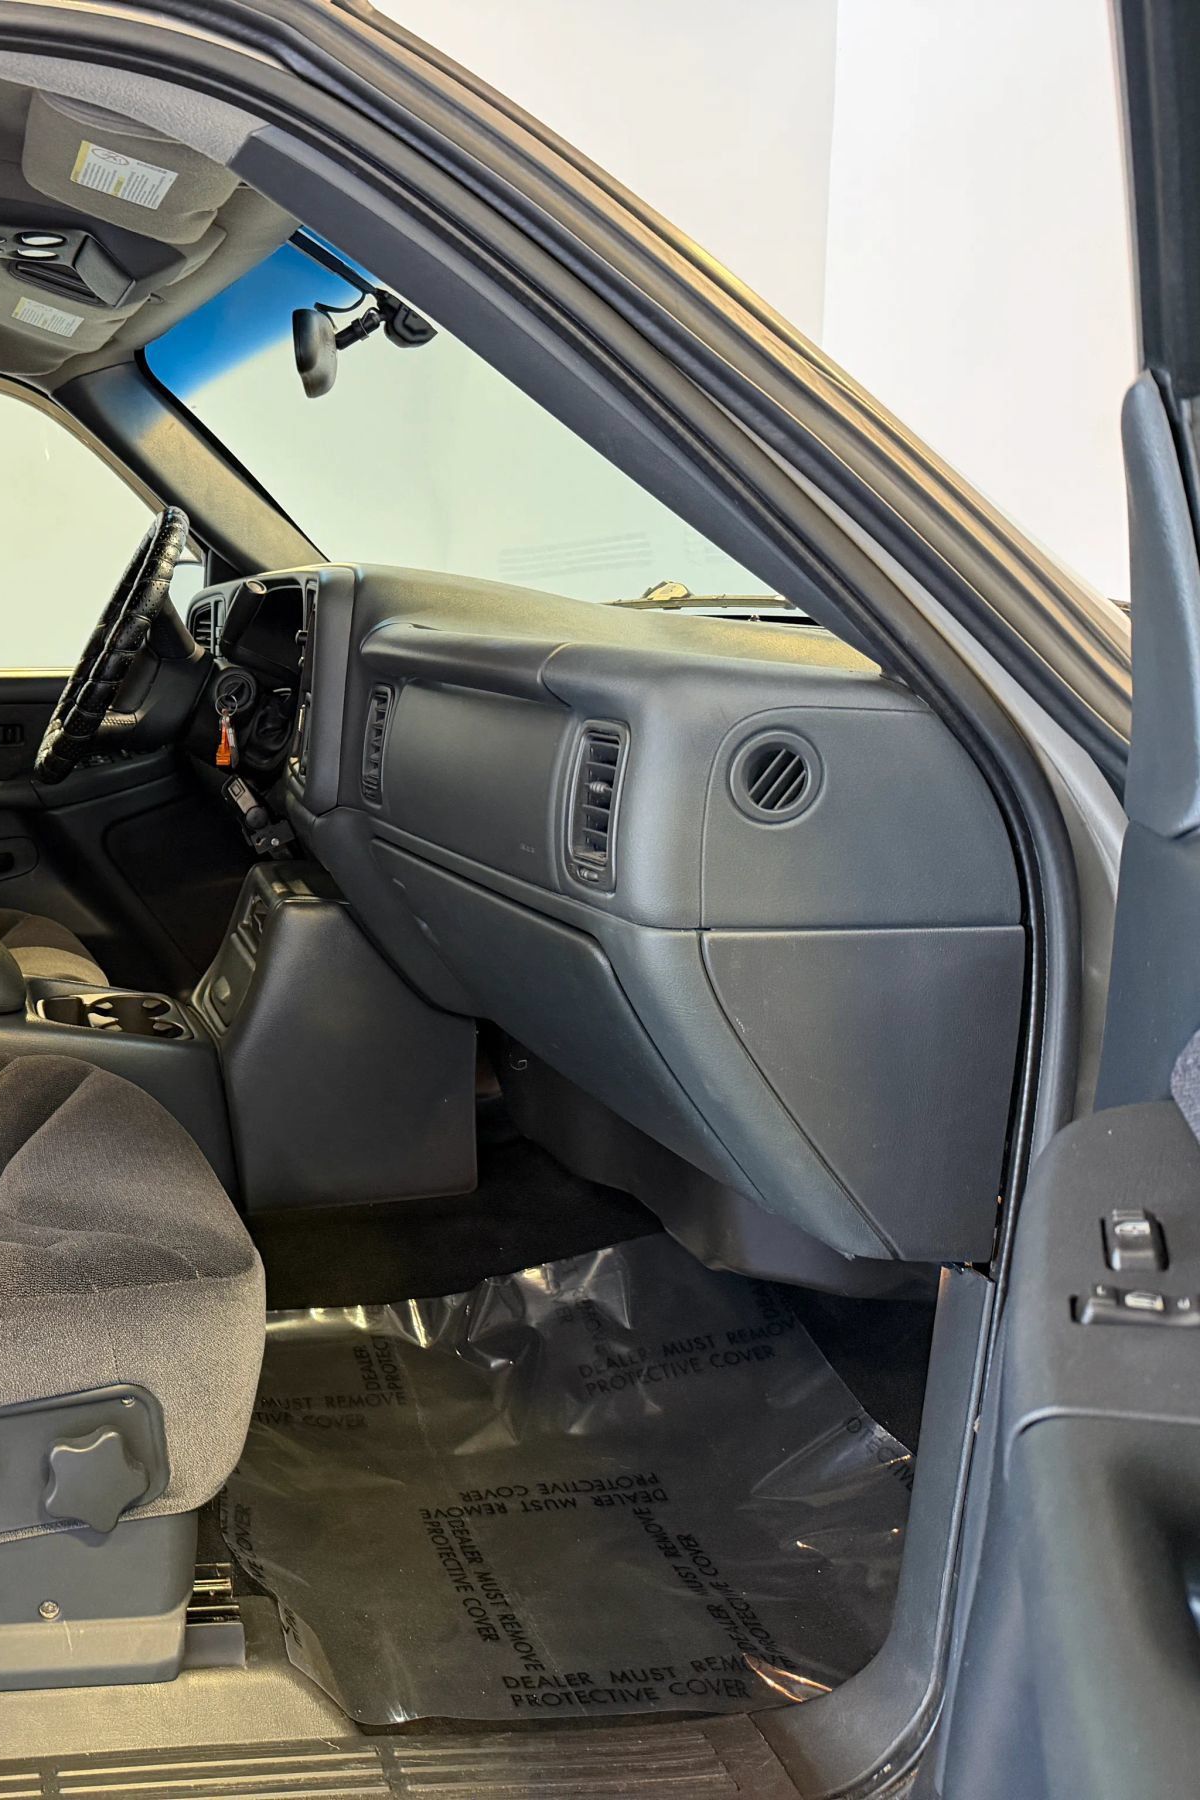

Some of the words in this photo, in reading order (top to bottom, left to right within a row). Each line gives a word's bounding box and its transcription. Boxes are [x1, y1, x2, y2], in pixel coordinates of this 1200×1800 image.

[662, 1334, 716, 1357] MUST
[353, 1345, 380, 1391] DEALER
[585, 1357, 704, 1395] PROTECTIVE
[709, 1345, 775, 1368] COVER
[260, 1395, 312, 1410] MUST
[324, 1391, 408, 1408] REMOVE
[459, 1484, 529, 1504] COVER
[537, 1471, 660, 1496] PROTECTIVE
[419, 1502, 508, 1520] REMOVE
[521, 1497, 577, 1513] MUST
[593, 1488, 669, 1508] DEALER
[633, 1507, 683, 1558] REMOVE
[676, 1533, 719, 1577] COVER
[422, 1520, 475, 1593] PROTECTIVE
[462, 1597, 500, 1643] COVER
[447, 1517, 484, 1564] DEALER
[475, 1570, 510, 1609] MUST
[497, 1611, 546, 1672] REMOVE
[706, 1603, 758, 1652] DEALER
[502, 1671, 593, 1690] DEALER
[609, 1666, 678, 1685] MUST
[510, 1687, 660, 1708] PROTECTIVE
[668, 1677, 751, 1699] COVER
